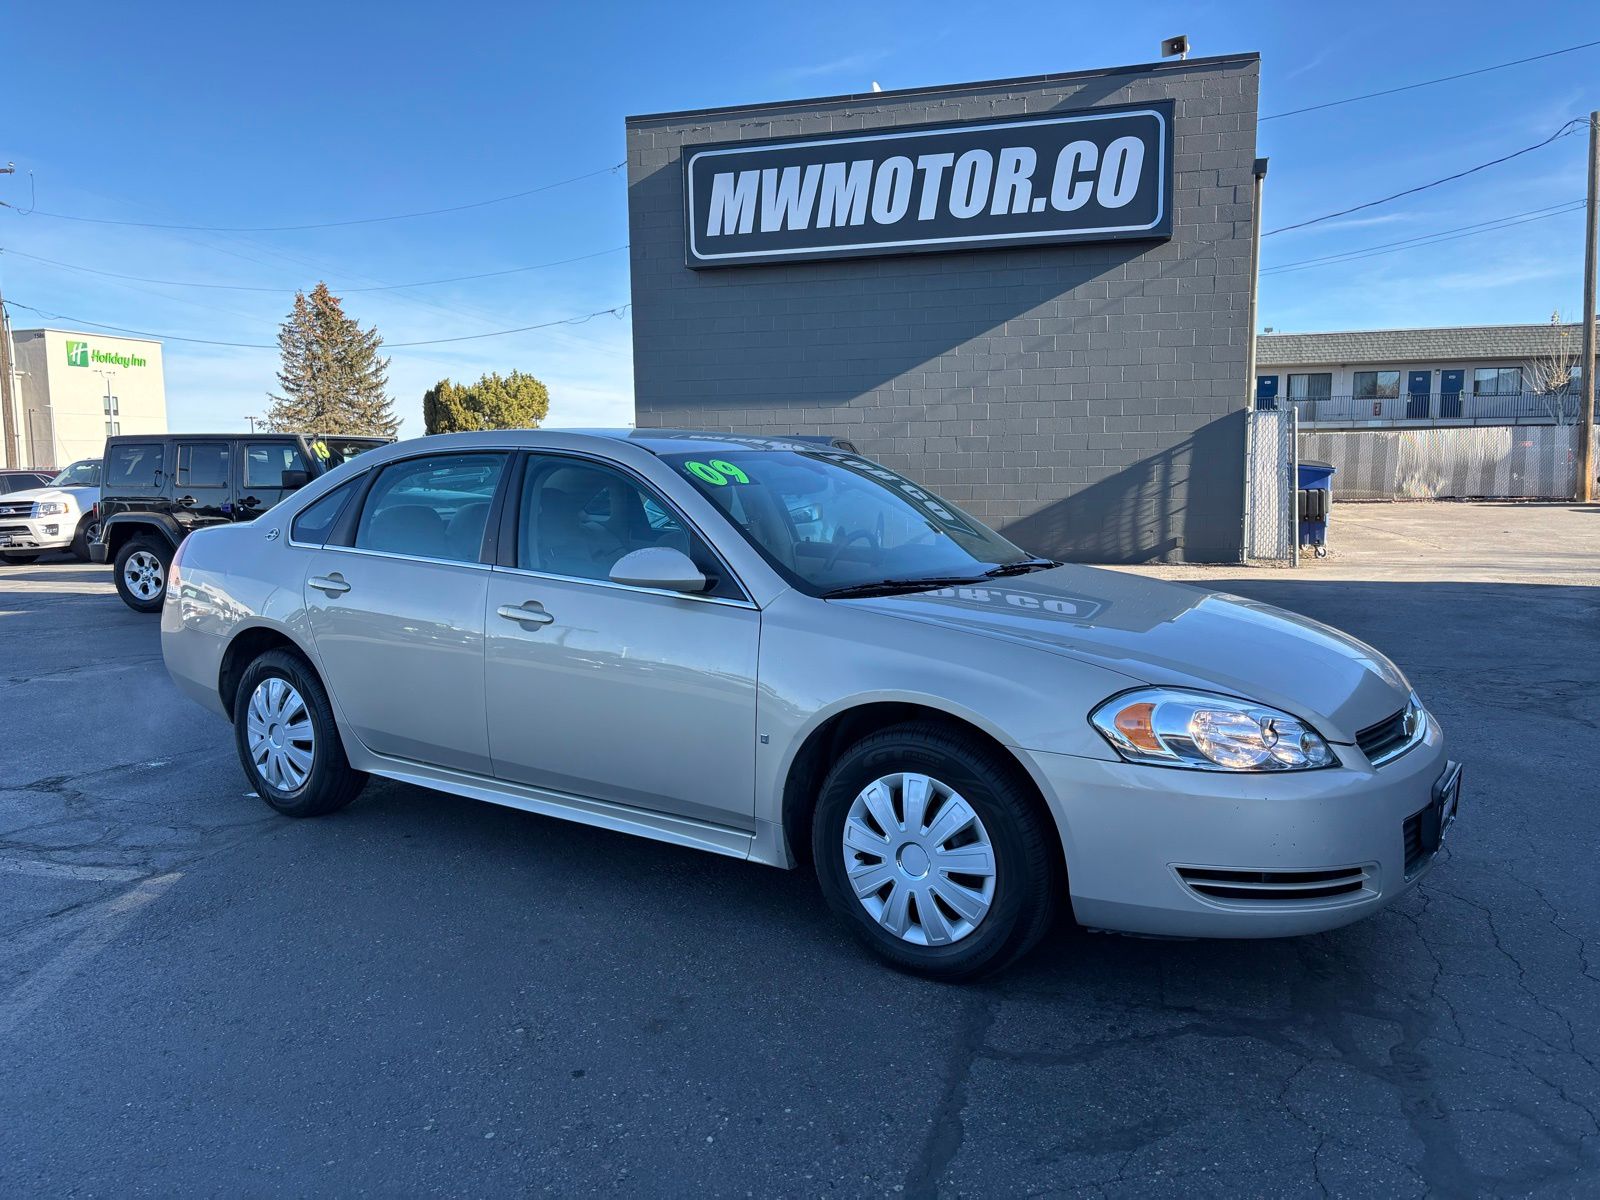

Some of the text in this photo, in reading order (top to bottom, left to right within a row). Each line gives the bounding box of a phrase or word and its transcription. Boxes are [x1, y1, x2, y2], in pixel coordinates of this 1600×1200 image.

[705, 135, 1145, 237] MWMOTOR.CO
[91, 349, 146, 368] Holiday Inn
[312, 441, 330, 459] 13
[684, 459, 750, 486] 09
